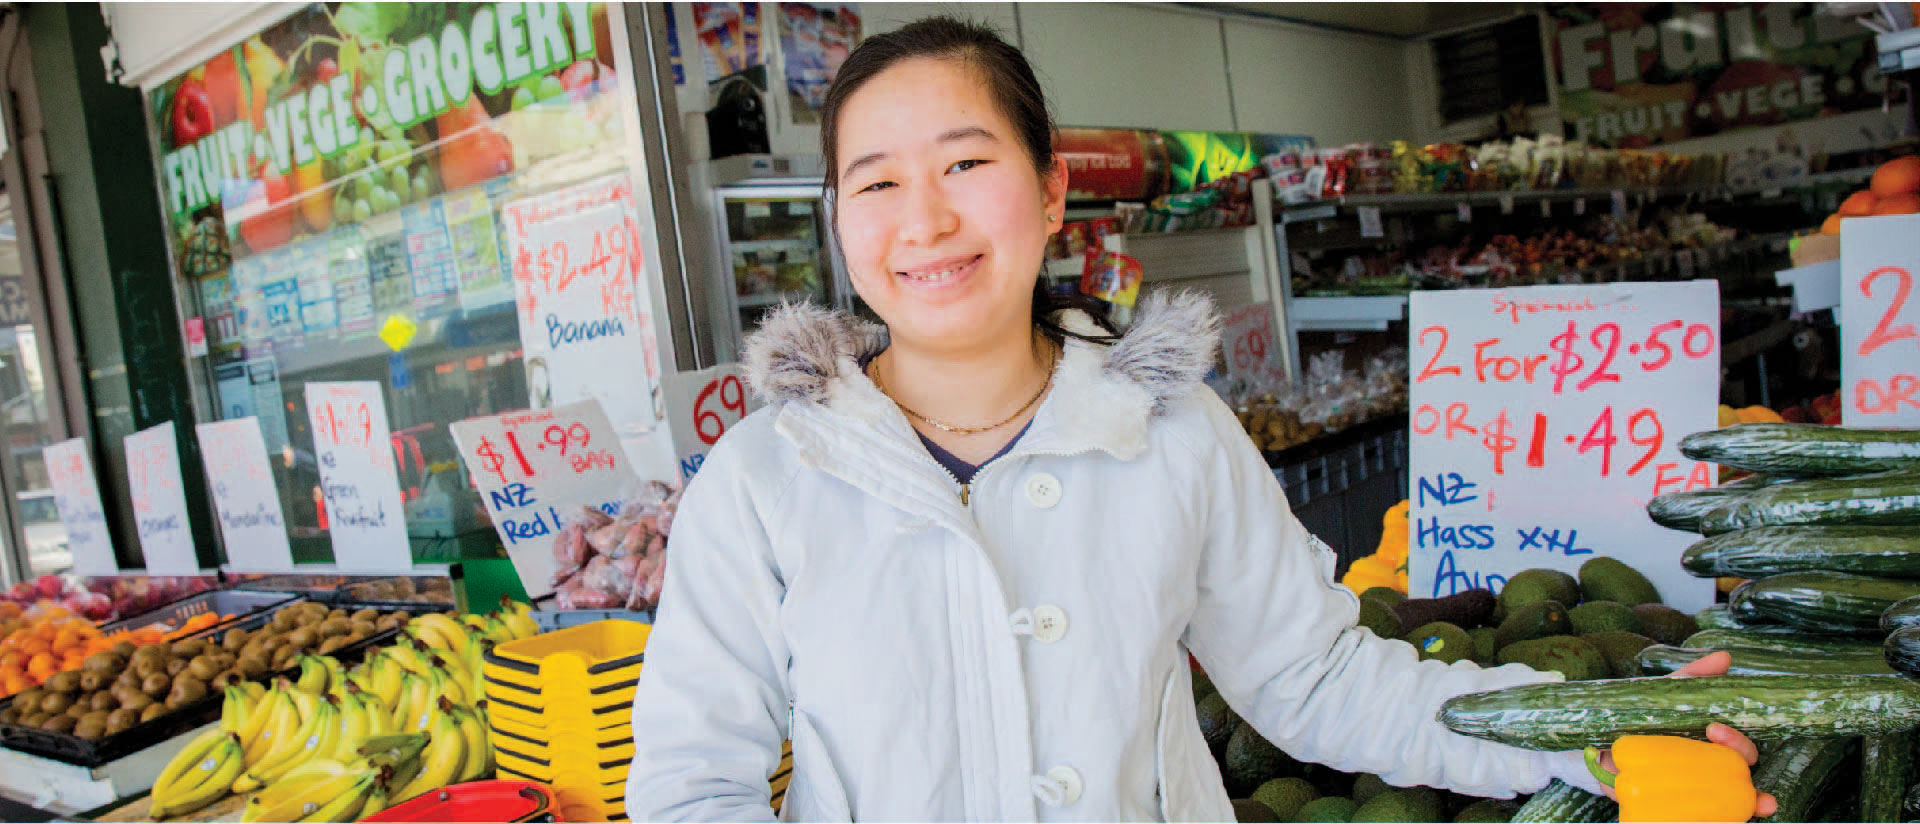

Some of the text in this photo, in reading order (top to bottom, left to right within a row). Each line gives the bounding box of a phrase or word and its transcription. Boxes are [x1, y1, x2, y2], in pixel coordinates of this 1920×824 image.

[163, 121, 254, 214] FRUIT
[265, 74, 361, 176] VEGE
[383, 3, 596, 130] GROCERY
[1577, 101, 1689, 145] FRUIT
[1716, 74, 1826, 120] VEGE
[537, 224, 627, 294] $2.49
[545, 313, 625, 350] Banana
[1417, 319, 1715, 394] 2 For $2.50
[476, 421, 591, 483] $1.99
[1413, 402, 1664, 477] OR $1.49
[490, 482, 537, 511] NZ
[1418, 472, 1478, 508] NZ
[502, 512, 550, 545] Red
[1417, 516, 1495, 549] Hass
